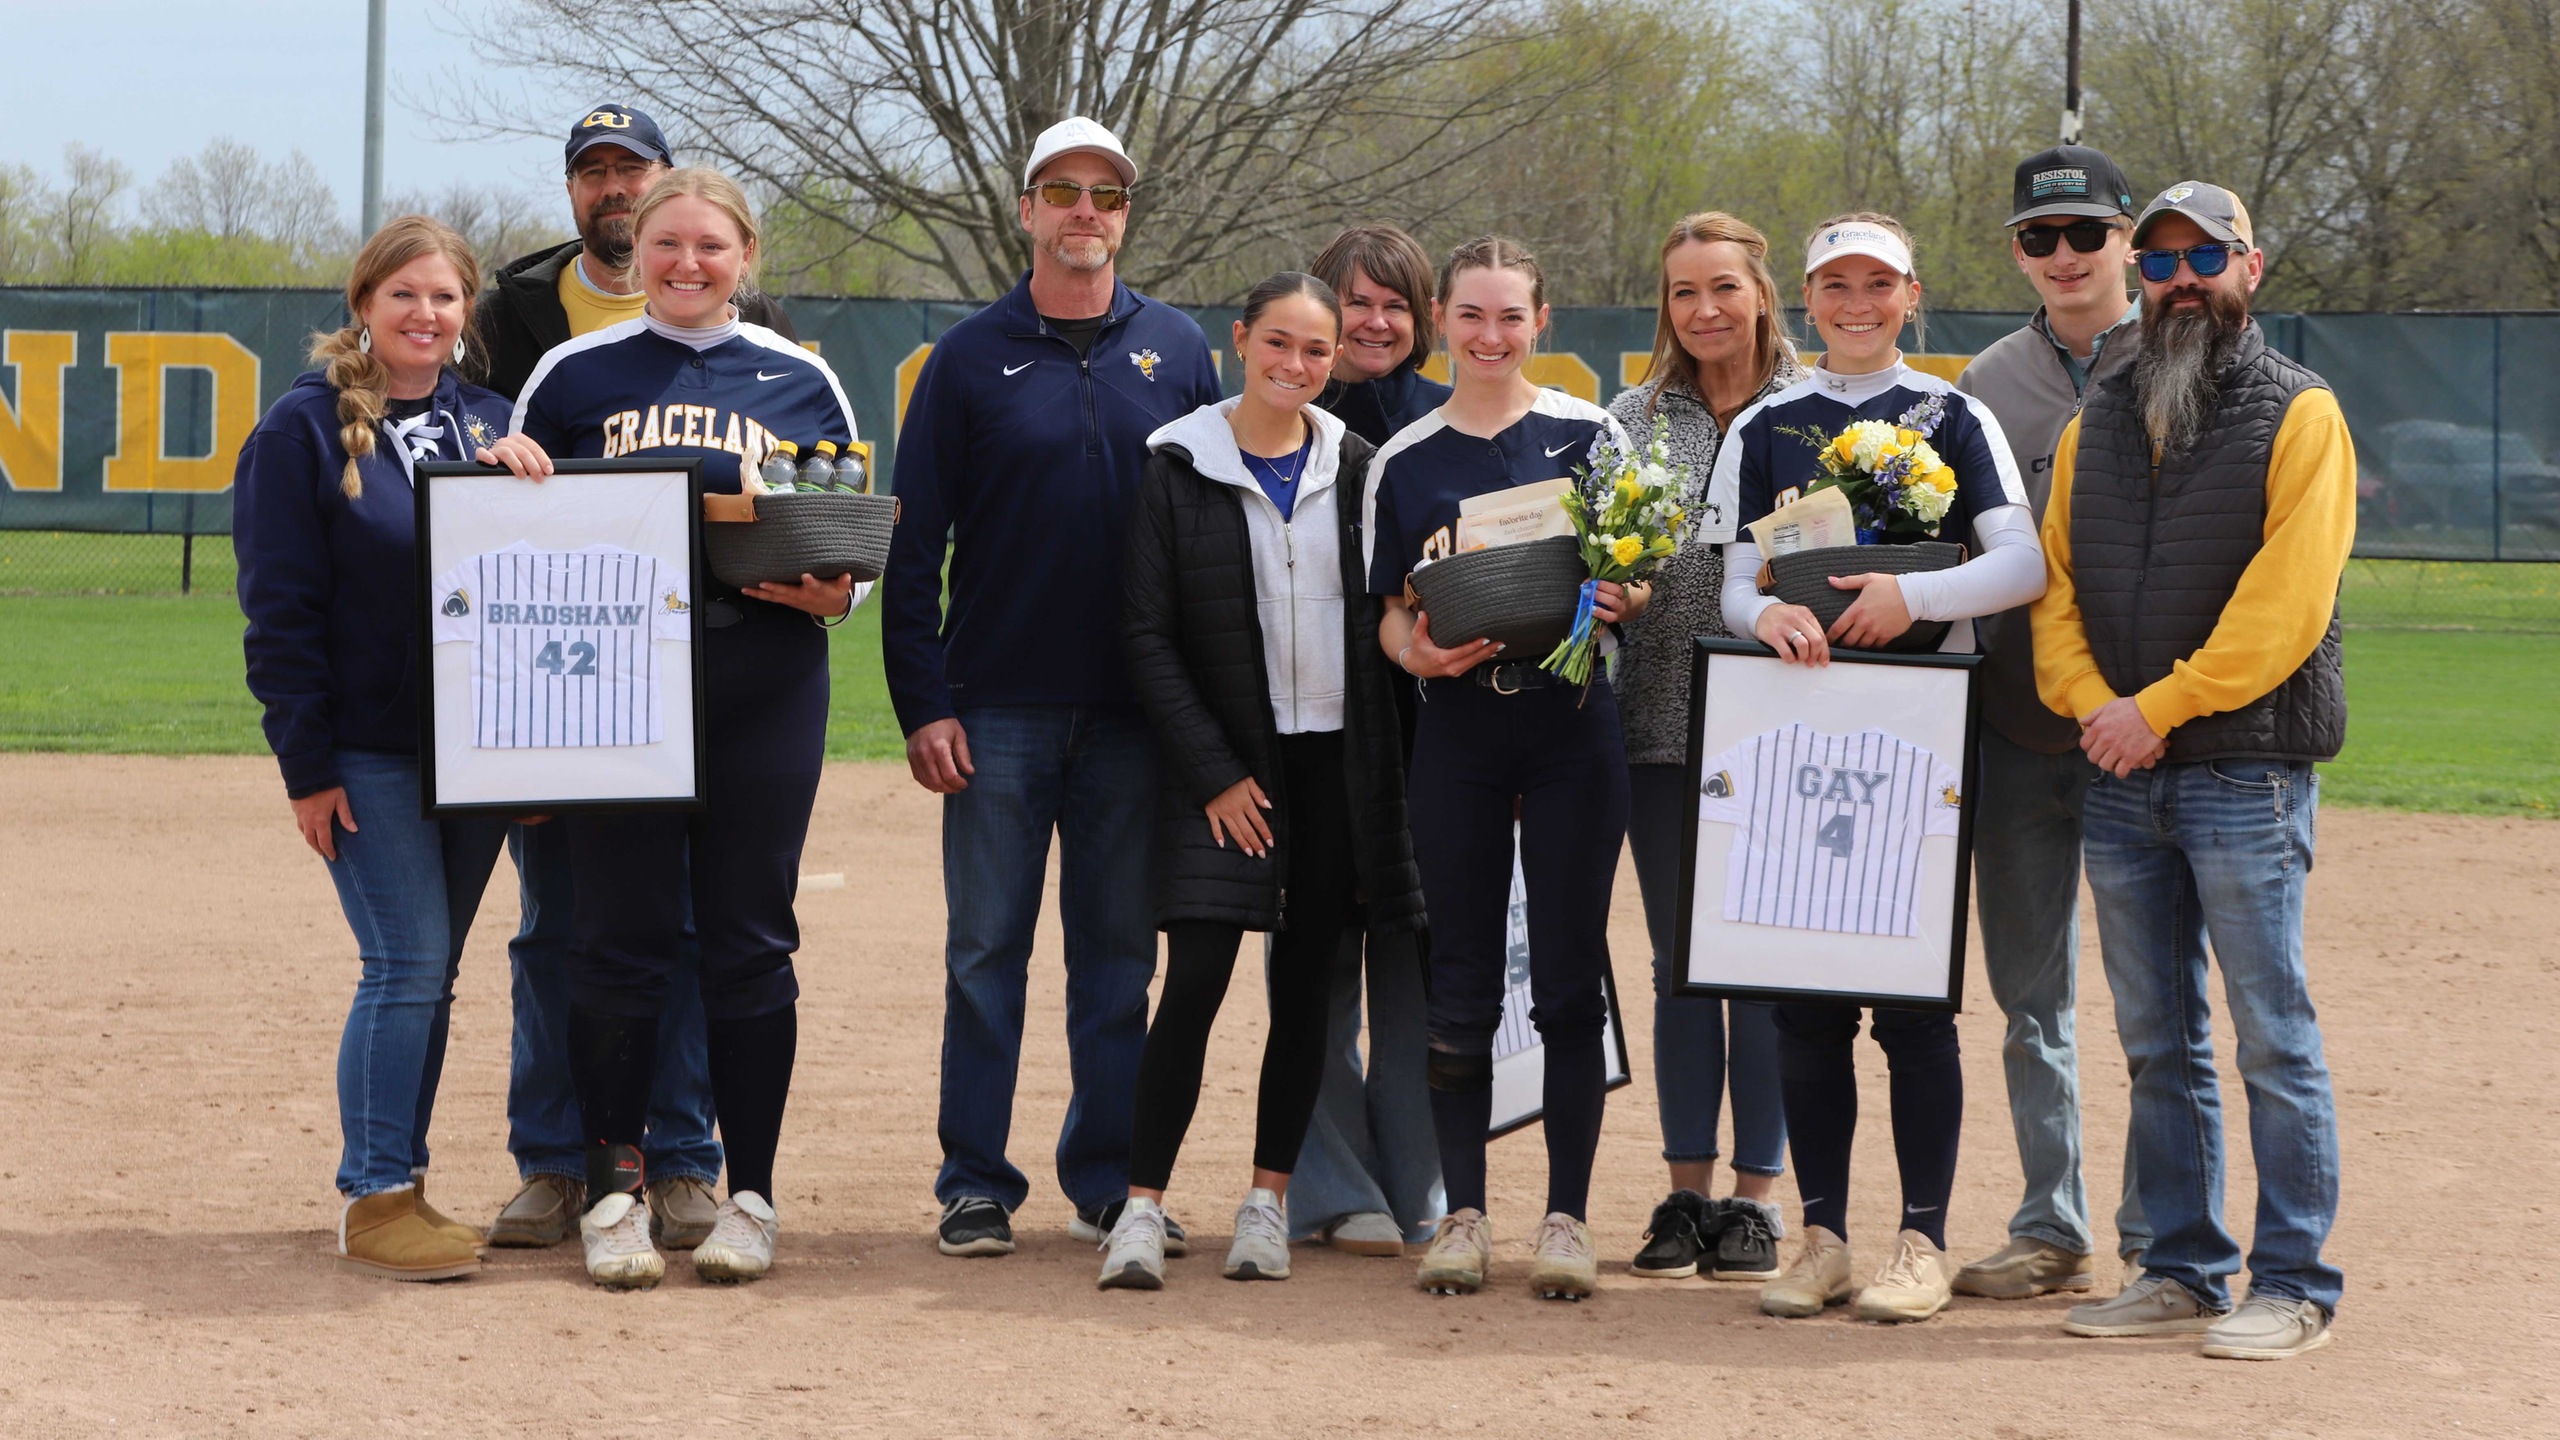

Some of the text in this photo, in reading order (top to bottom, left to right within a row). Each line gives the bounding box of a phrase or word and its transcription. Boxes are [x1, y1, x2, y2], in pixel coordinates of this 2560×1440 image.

[582, 112, 633, 128] GU
[2032, 169, 2087, 184] RESISTOL
[1842, 230, 1886, 242] Graceland
[1499, 512, 1529, 527] favorite
[1517, 522, 1544, 534] chocolate
[487, 602, 645, 627] BRADSHAW
[535, 641, 597, 676] 42
[1795, 763, 1890, 806] GAY
[1816, 814, 1854, 858] 4
